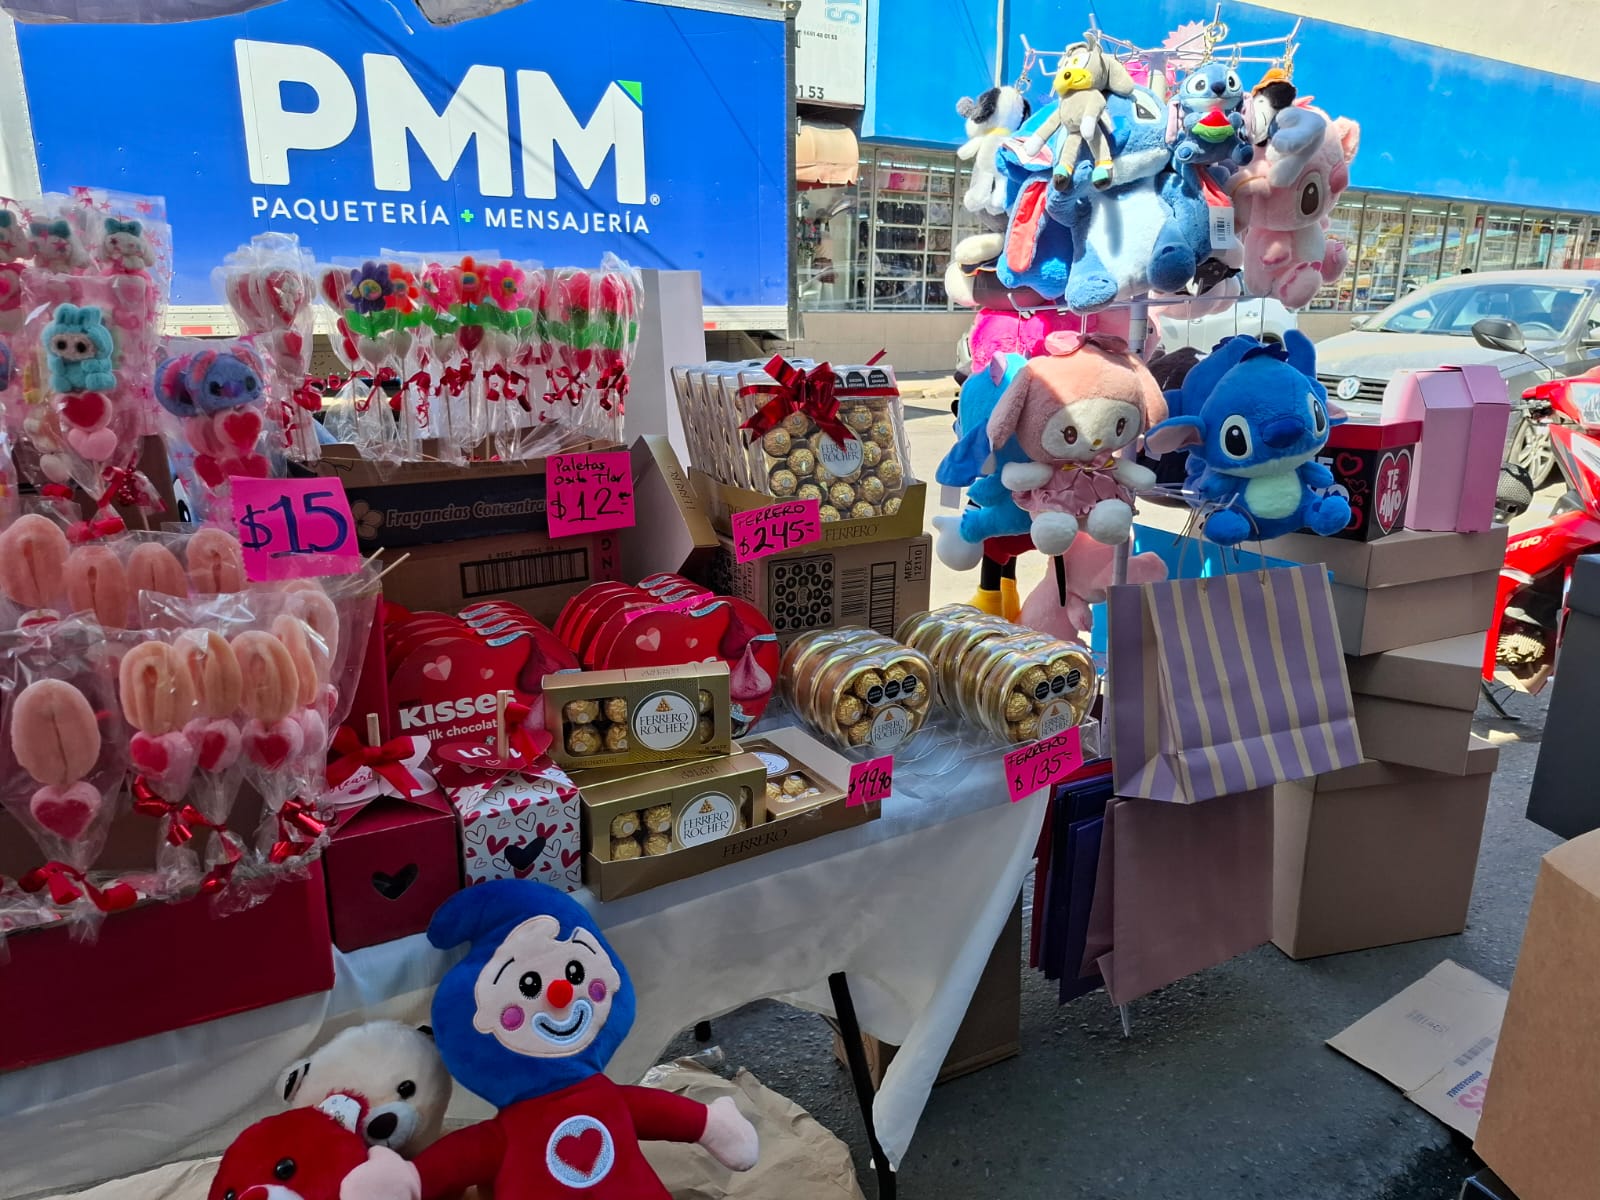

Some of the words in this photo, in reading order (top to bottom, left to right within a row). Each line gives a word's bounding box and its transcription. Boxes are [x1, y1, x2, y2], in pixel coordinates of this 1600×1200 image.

[808, 86, 825, 100] 53
[234, 38, 647, 205] PMM
[251, 196, 450, 226] PAQUETERÍA
[485, 207, 651, 235] MENSAJERÍA
[1387, 469, 1400, 490] TE
[386, 503, 471, 529] Fragancias
[472, 498, 546, 518] Concentra
[736, 503, 805, 528] FERRERO
[1379, 489, 1402, 523] AMO
[240, 491, 348, 558] $15
[825, 523, 879, 542] FERRERO
[914, 550, 922, 576] 12110
[446, 719, 499, 737] chocolat
[639, 712, 689, 726] FERRERO
[640, 722, 688, 736] ROCHER
[1007, 736, 1068, 766] FERRERO
[683, 811, 729, 830] FERRERO
[684, 820, 729, 840] ROCHER
[722, 828, 788, 858] FERRERO
